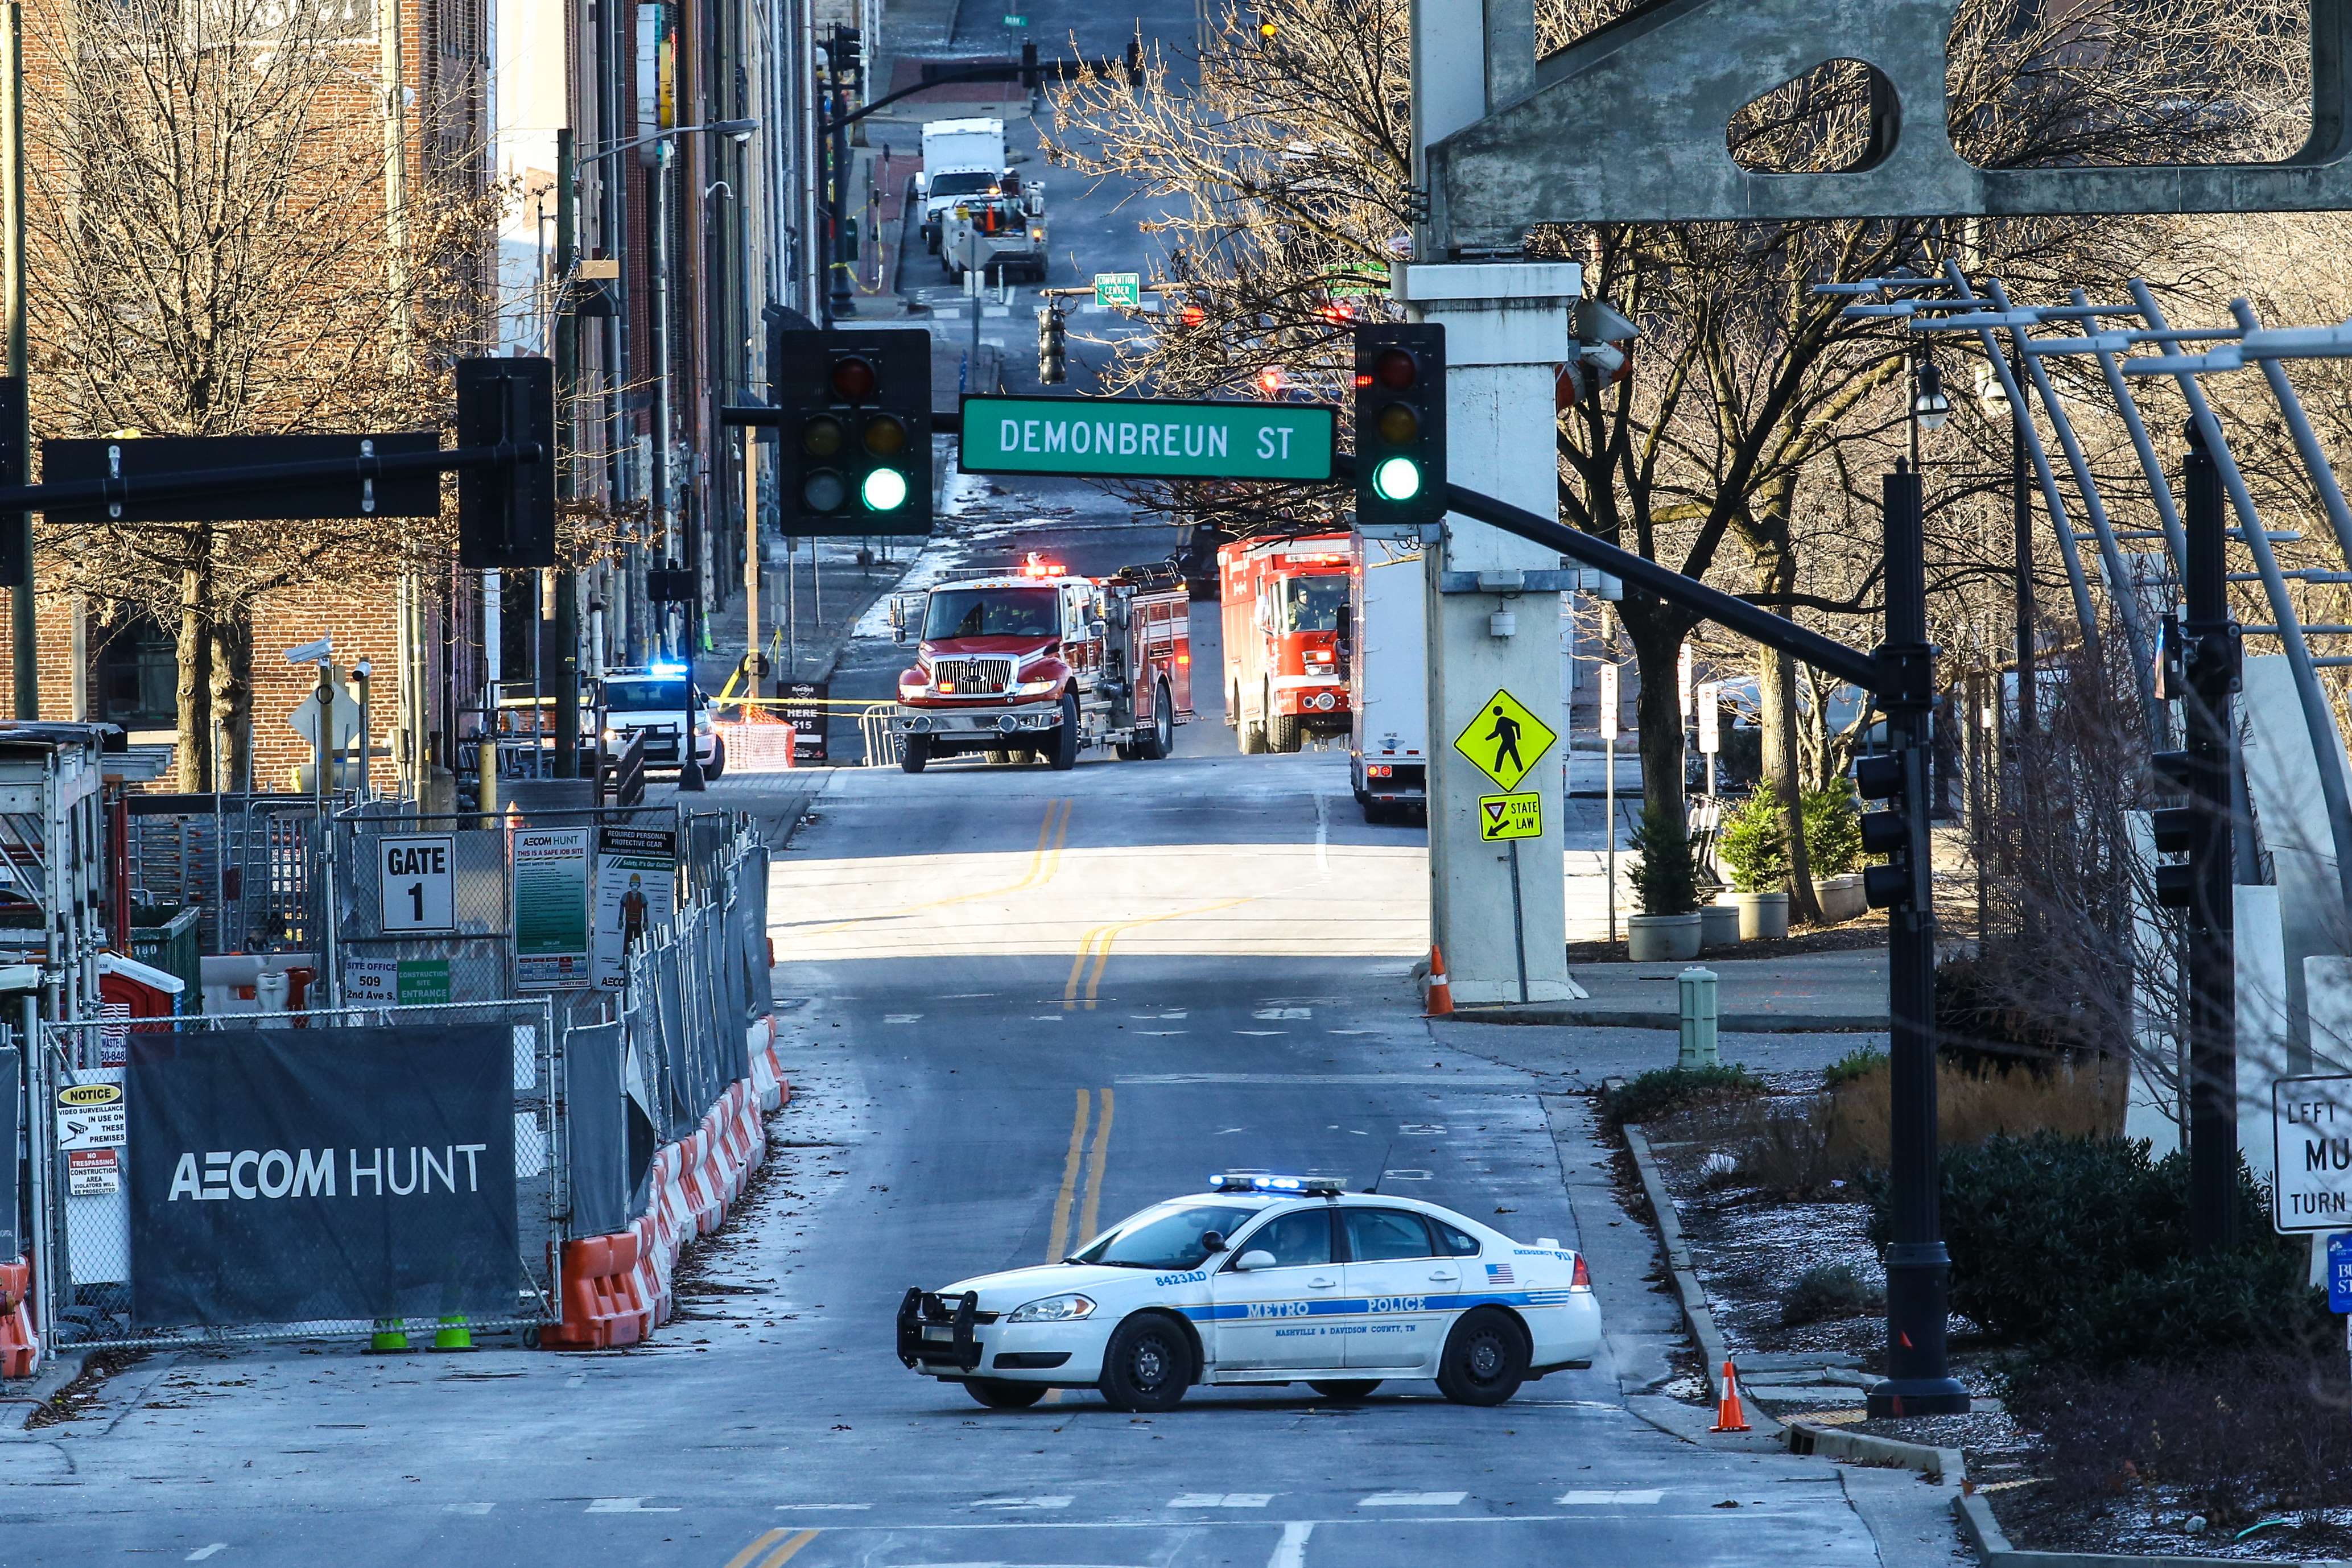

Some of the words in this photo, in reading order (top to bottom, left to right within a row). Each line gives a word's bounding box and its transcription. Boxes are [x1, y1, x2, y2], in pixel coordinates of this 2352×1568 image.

[1098, 275, 1136, 284] CONVENTION
[1104, 285, 1129, 295] CENTER
[1001, 419, 1227, 457] DEMONBREUN
[1256, 427, 1293, 459] ST
[787, 709, 817, 717] HERE
[1511, 802, 1538, 814] STATE
[1516, 818, 1534, 829] LAW
[523, 837, 551, 846] AECOM
[553, 835, 578, 845] HUNT
[388, 847, 445, 876] GATE
[408, 882, 423, 921] 1
[368, 963, 397, 971] OFFICE
[359, 976, 381, 987] 509
[346, 990, 363, 999] 2nd
[366, 991, 384, 1000] Ave
[387, 992, 396, 1001] S.
[402, 989, 447, 998] ENTRANCE
[71, 1088, 111, 1101] NOTICE
[2288, 1101, 2336, 1124] LEFT
[89, 1134, 125, 1142] PREMISES
[70, 1167, 117, 1176] CONSTRUCTION
[168, 1148, 336, 1201] AECOM
[349, 1144, 486, 1196] HUNT
[2291, 1191, 2345, 1215] TURN
[1554, 1252, 1572, 1260] 911
[1156, 1271, 1206, 1286] 8423AD
[1247, 1302, 1309, 1318] METRO
[1368, 1297, 1426, 1313] POLICE
